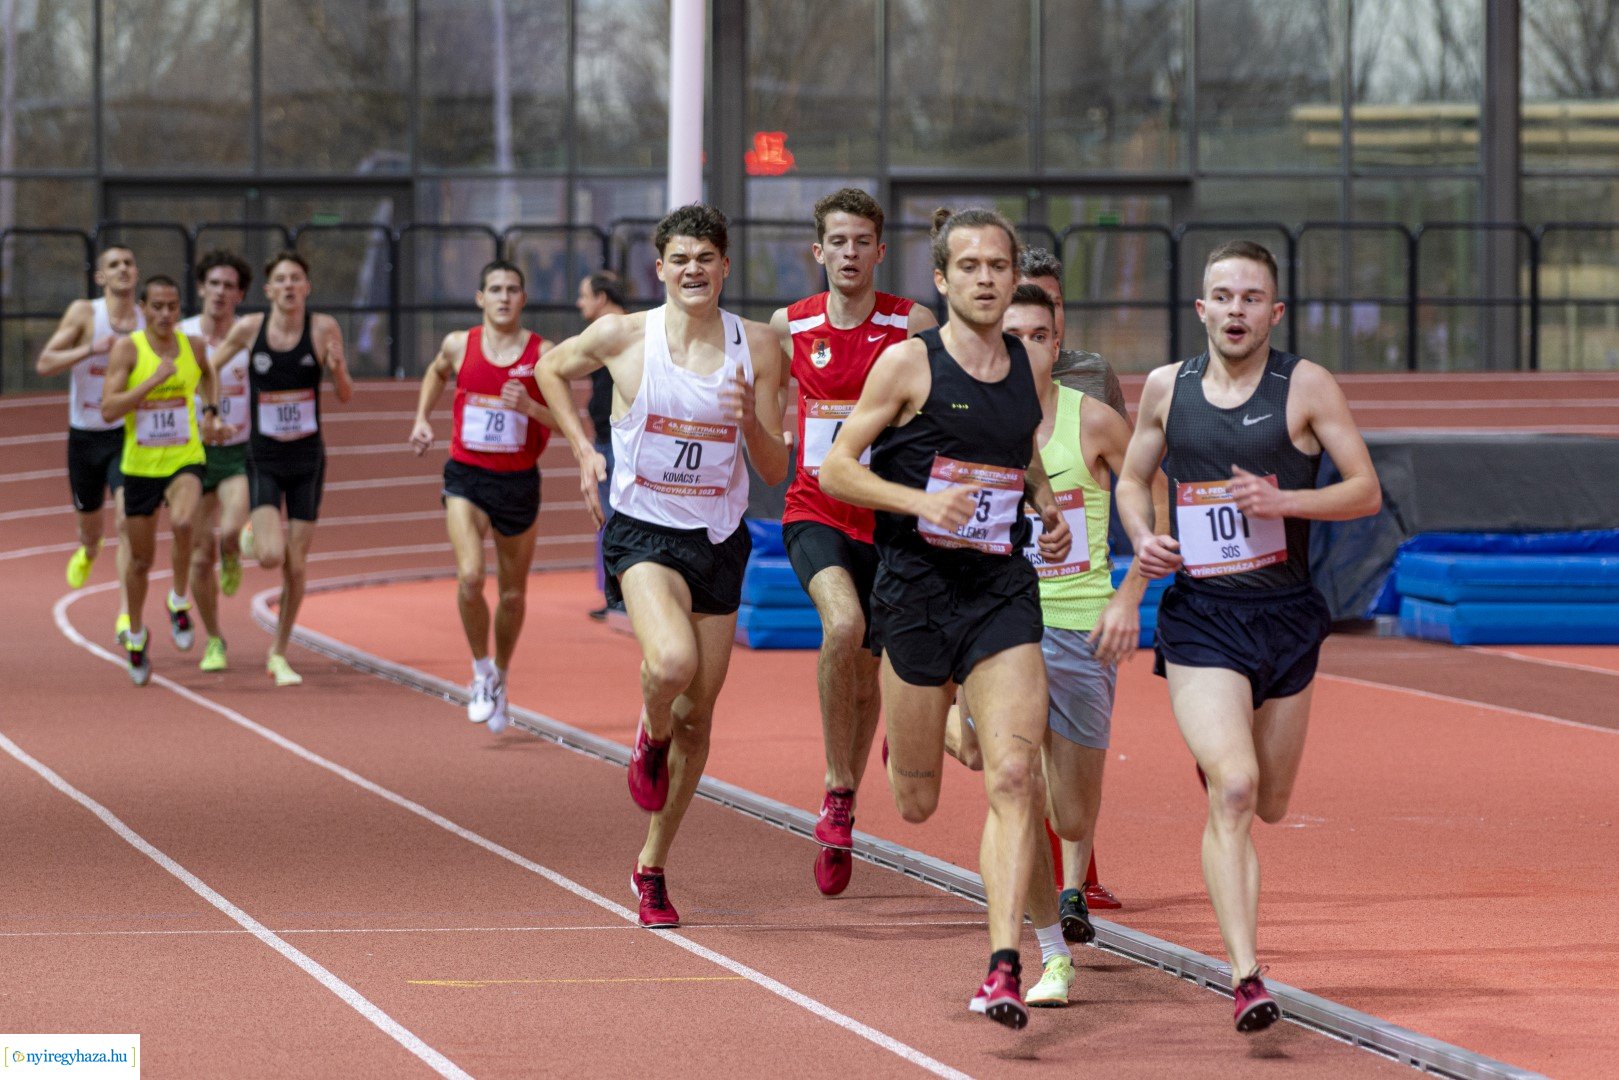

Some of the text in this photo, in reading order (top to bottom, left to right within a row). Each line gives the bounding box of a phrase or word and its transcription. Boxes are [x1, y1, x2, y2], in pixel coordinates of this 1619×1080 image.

[153, 411, 175, 429] 114
[277, 403, 301, 422] 105
[485, 410, 505, 432] 78
[673, 439, 703, 471] 70
[662, 471, 702, 484] KOVÁCS F.
[643, 481, 716, 496] NYÍREGYHÁZA 2023
[974, 489, 993, 523] 5
[1205, 505, 1250, 542] 101
[948, 526, 990, 540] ELEMEN
[1221, 545, 1241, 559] SÓS
[1060, 565, 1081, 576] 2023
[1190, 561, 1255, 576] NYÍREGYHÁZA
